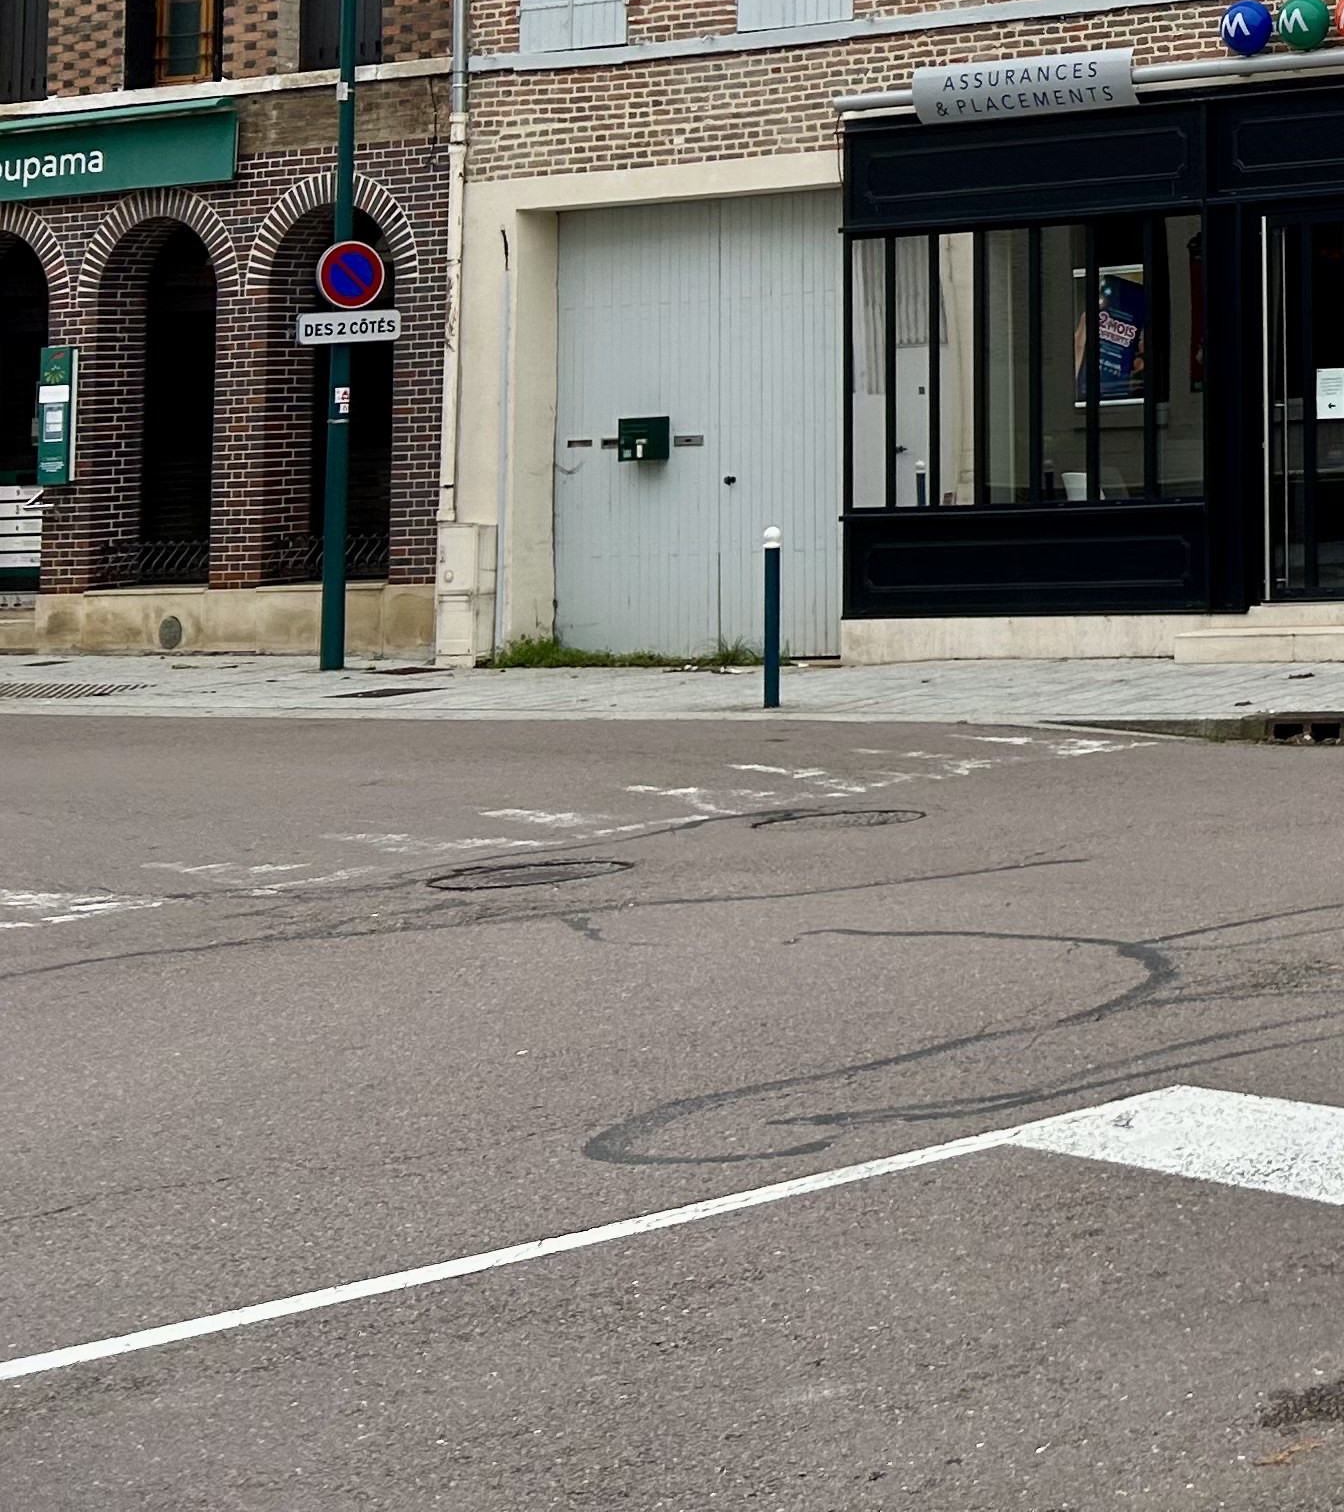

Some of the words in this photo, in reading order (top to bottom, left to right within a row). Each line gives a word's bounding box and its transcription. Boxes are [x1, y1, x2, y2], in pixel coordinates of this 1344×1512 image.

[942, 61, 1098, 92] ASSURANCES
[936, 101, 949, 117] &
[956, 85, 1114, 115] PLACEMENTS
[0, 149, 104, 188] upama
[304, 323, 333, 337] DES
[336, 322, 347, 336] 2
[349, 317, 396, 335] CÔTÉS
[1108, 321, 1136, 338] MOIS
